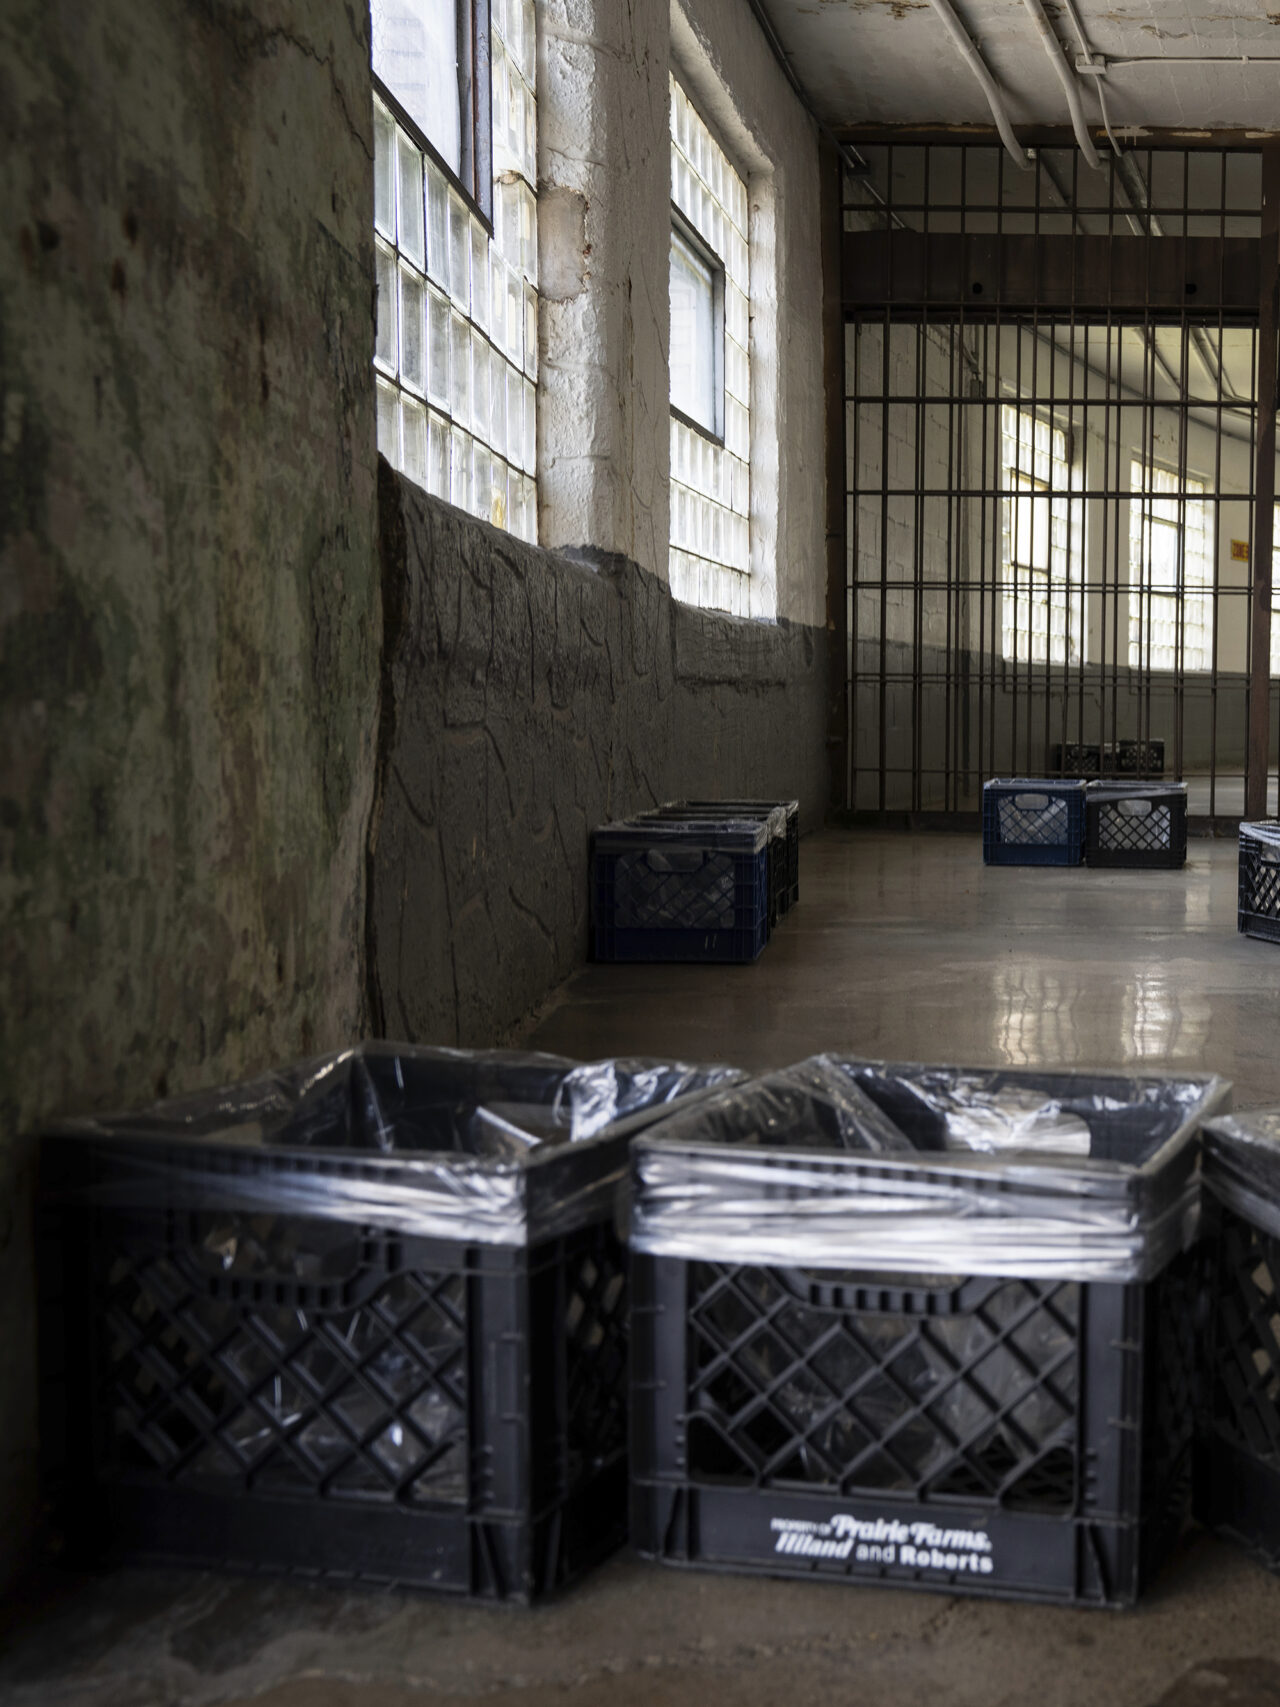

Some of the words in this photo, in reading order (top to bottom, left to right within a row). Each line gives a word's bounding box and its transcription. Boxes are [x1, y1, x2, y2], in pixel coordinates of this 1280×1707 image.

[830, 1514, 909, 1545] Prairie
[774, 1532, 855, 1559] Hiland
[856, 1544, 896, 1564] and
[899, 1545, 994, 1574] Roberts
